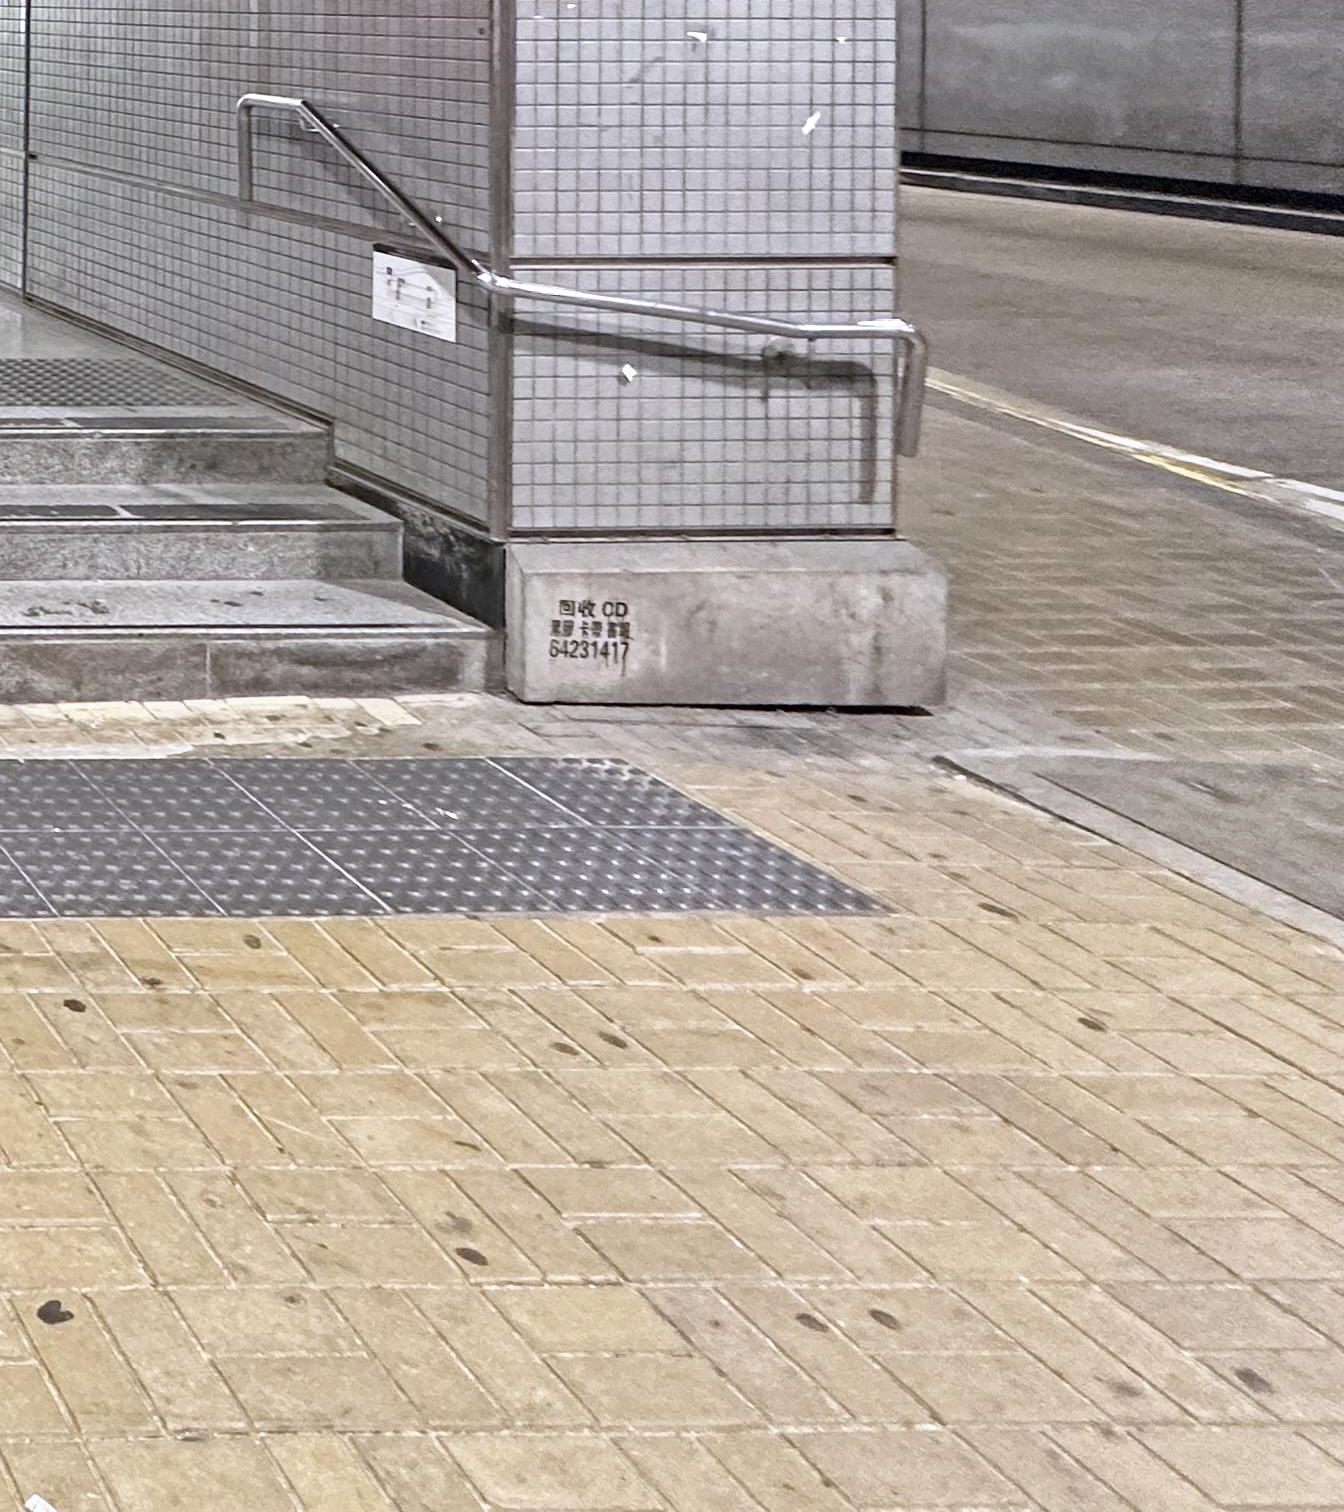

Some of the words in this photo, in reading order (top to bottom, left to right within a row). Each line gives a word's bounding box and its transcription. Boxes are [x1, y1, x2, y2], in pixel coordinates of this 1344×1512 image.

[559, 599, 596, 617] 回收
[602, 601, 628, 617] CD
[549, 639, 630, 661] 64231417
